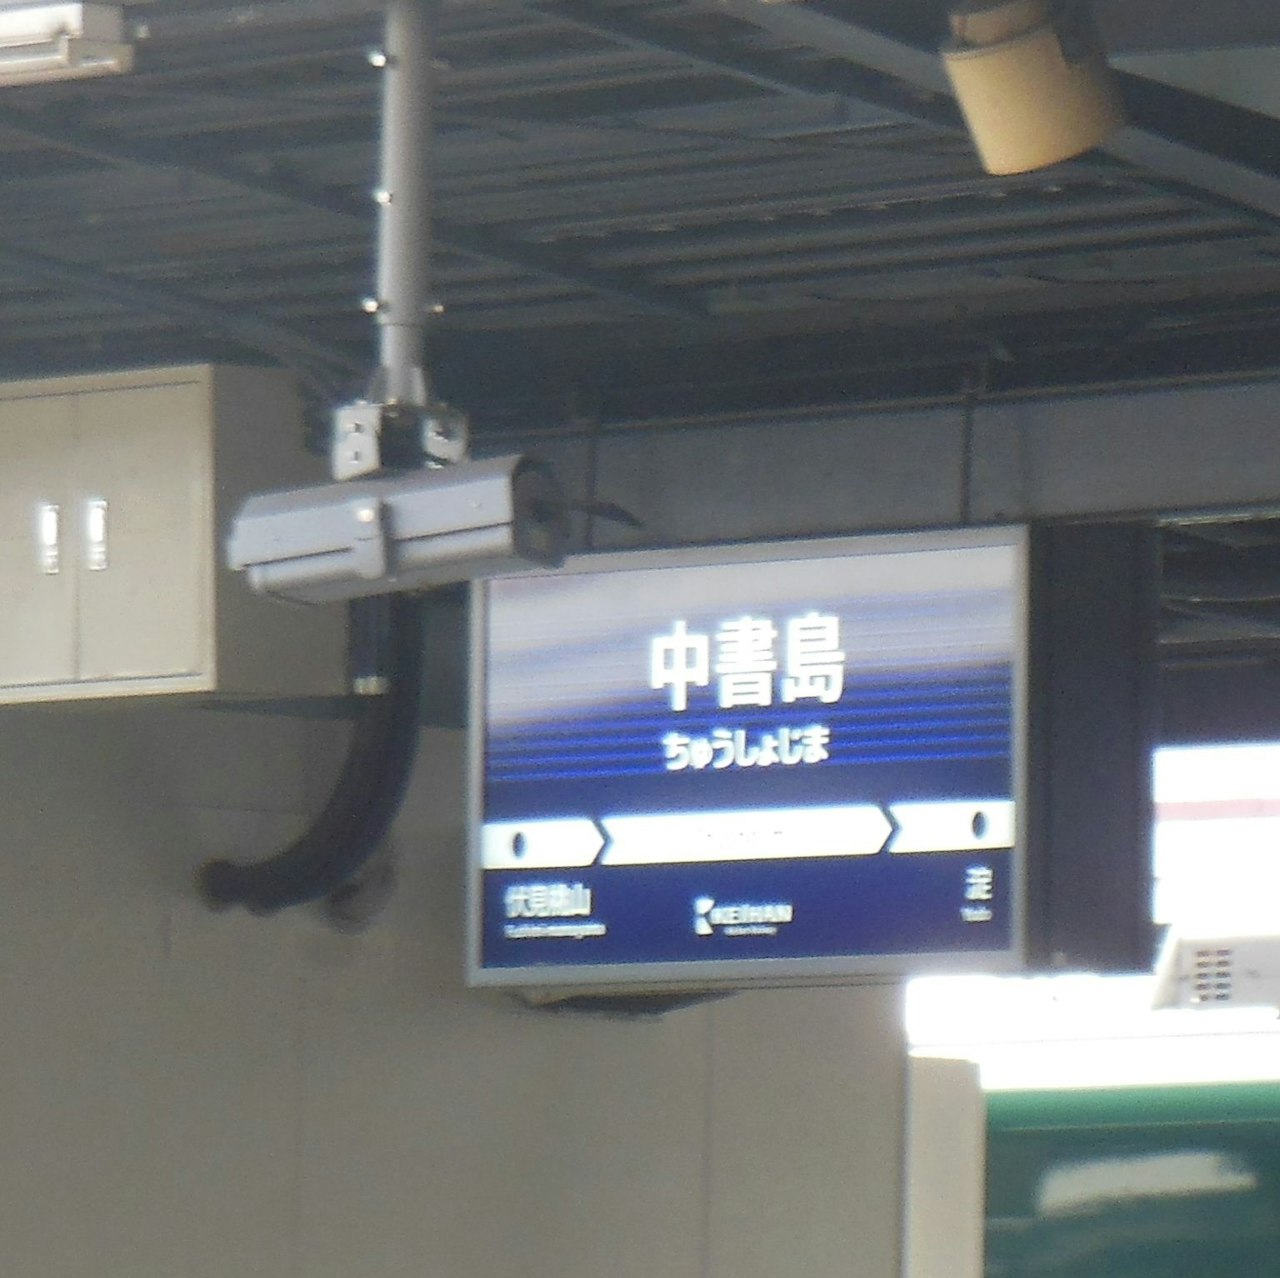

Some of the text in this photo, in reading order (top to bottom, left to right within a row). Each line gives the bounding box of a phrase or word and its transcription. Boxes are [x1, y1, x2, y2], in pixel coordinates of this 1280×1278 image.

[648, 612, 847, 713] 中書島
[661, 723, 832, 774] ちゅうしょじま
